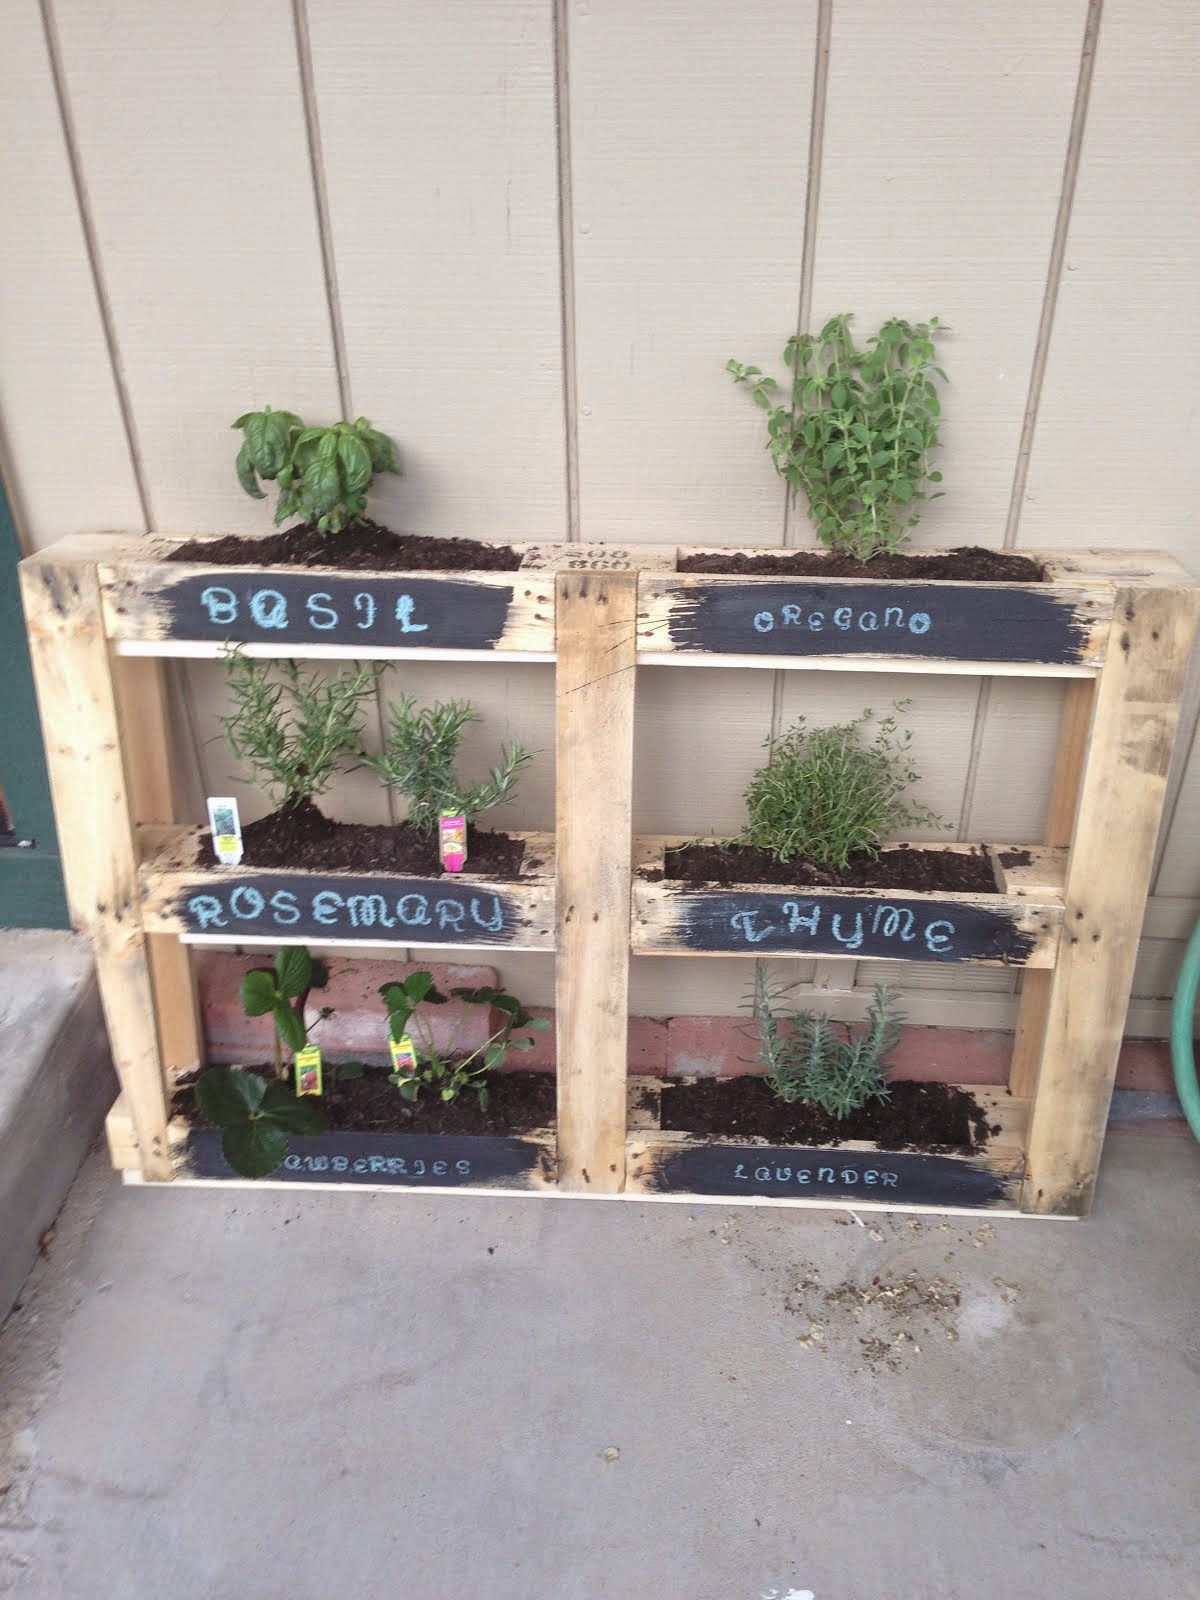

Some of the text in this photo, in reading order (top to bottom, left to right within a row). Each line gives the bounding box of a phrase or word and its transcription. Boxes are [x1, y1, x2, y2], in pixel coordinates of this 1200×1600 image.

[200, 586, 429, 634] BASIL
[187, 885, 504, 933] ROSEMARY
[730, 901, 956, 953] THYME
[283, 1154, 473, 1176] AWBERRIES
[734, 1163, 900, 1188] LAVENDER
